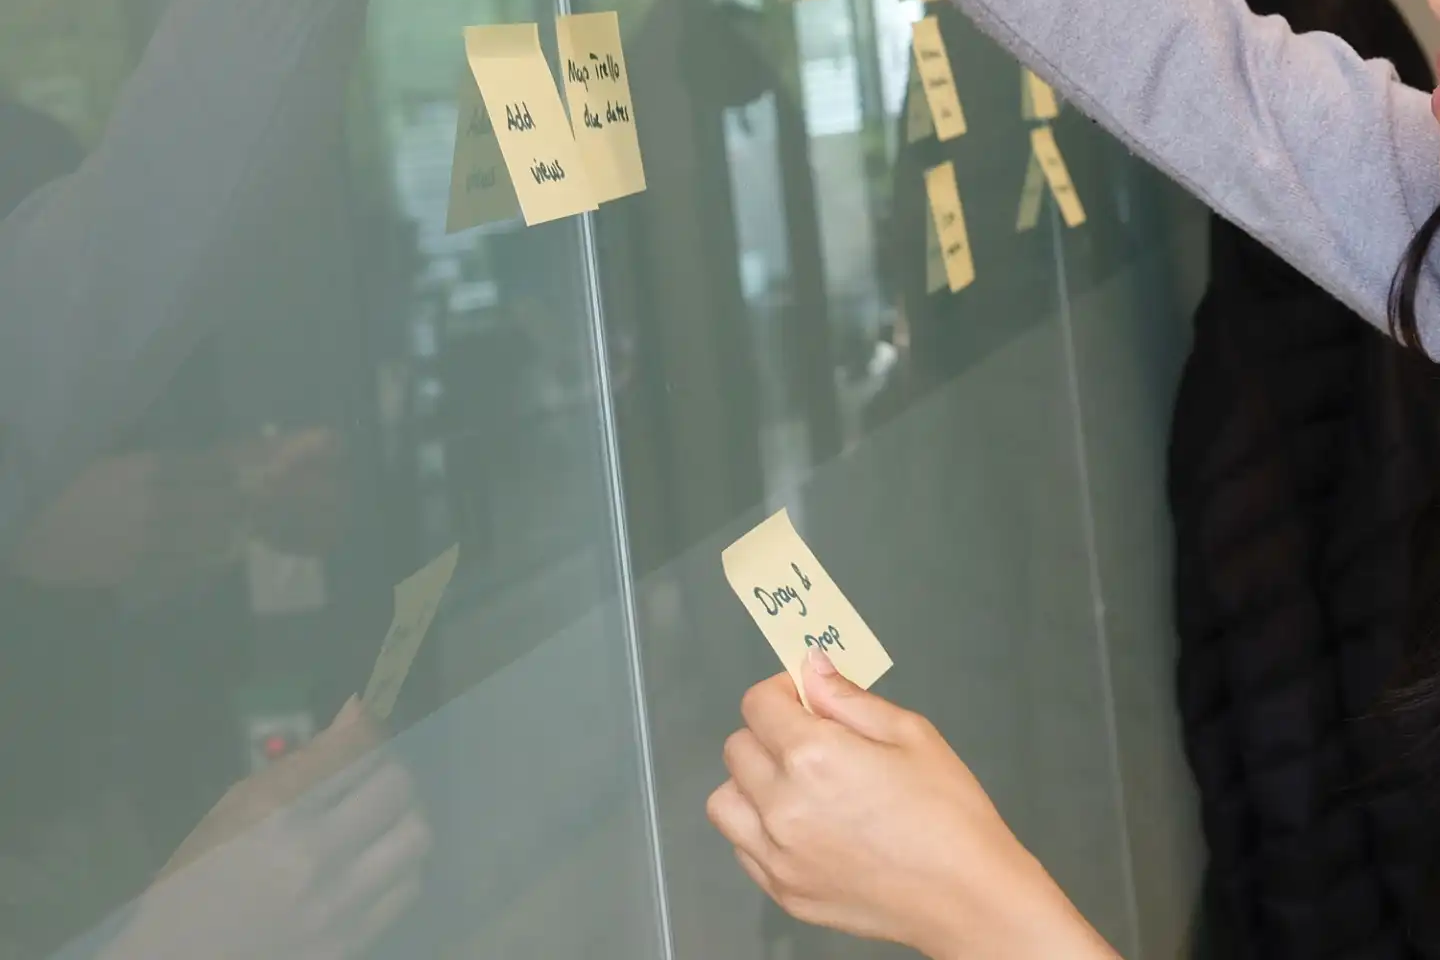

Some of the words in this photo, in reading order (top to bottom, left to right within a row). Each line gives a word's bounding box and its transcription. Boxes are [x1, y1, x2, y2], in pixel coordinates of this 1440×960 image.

[568, 59, 590, 92] Map
[589, 52, 620, 83] Trello
[505, 101, 536, 132] Add
[583, 103, 603, 129] due
[606, 100, 629, 124] dates
[530, 158, 565, 185] views
[753, 585, 808, 617] Drag
[790, 561, 812, 591] &
